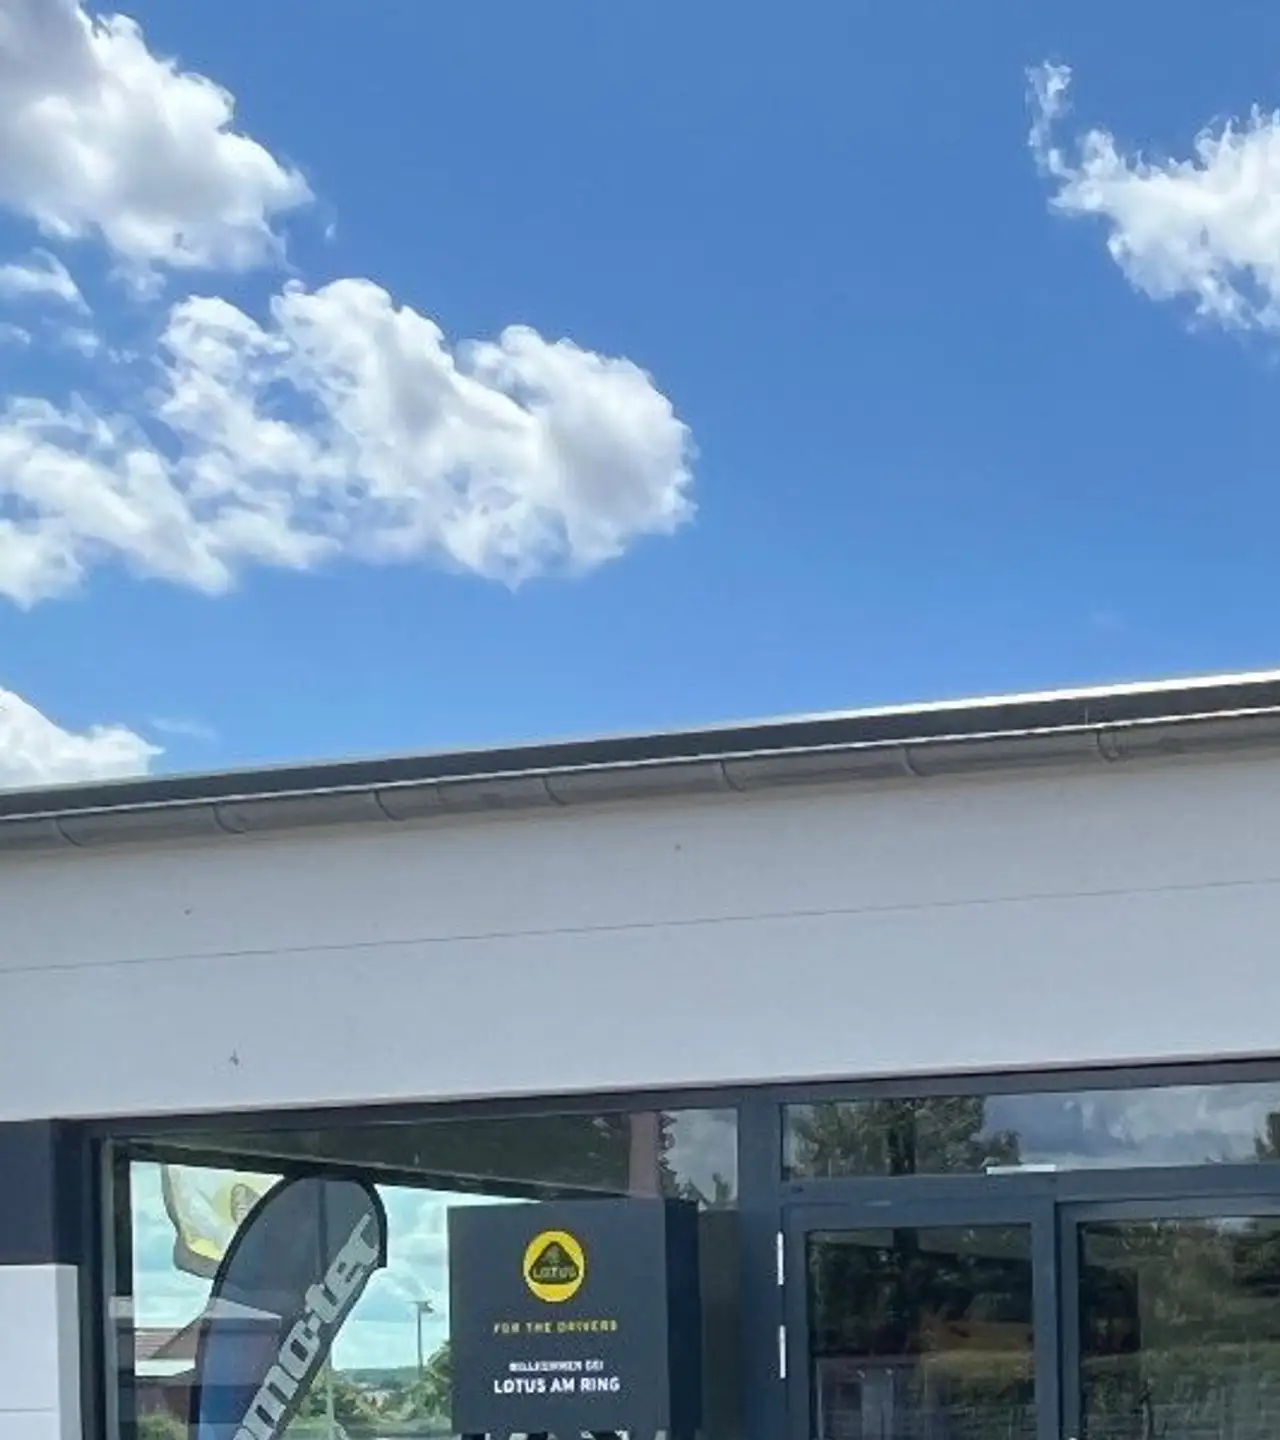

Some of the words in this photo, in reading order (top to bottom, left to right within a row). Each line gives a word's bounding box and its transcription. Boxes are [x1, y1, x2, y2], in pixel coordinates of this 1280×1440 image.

[532, 1267, 577, 1279] LOTUS
[494, 1322, 520, 1334] FOR
[526, 1322, 551, 1333] THE
[557, 1319, 618, 1333] DRIVERS
[509, 1361, 581, 1372] WILLKOMMEN
[494, 1378, 546, 1393] LOTUS
[550, 1377, 575, 1392] AM
[580, 1376, 620, 1392] RING
